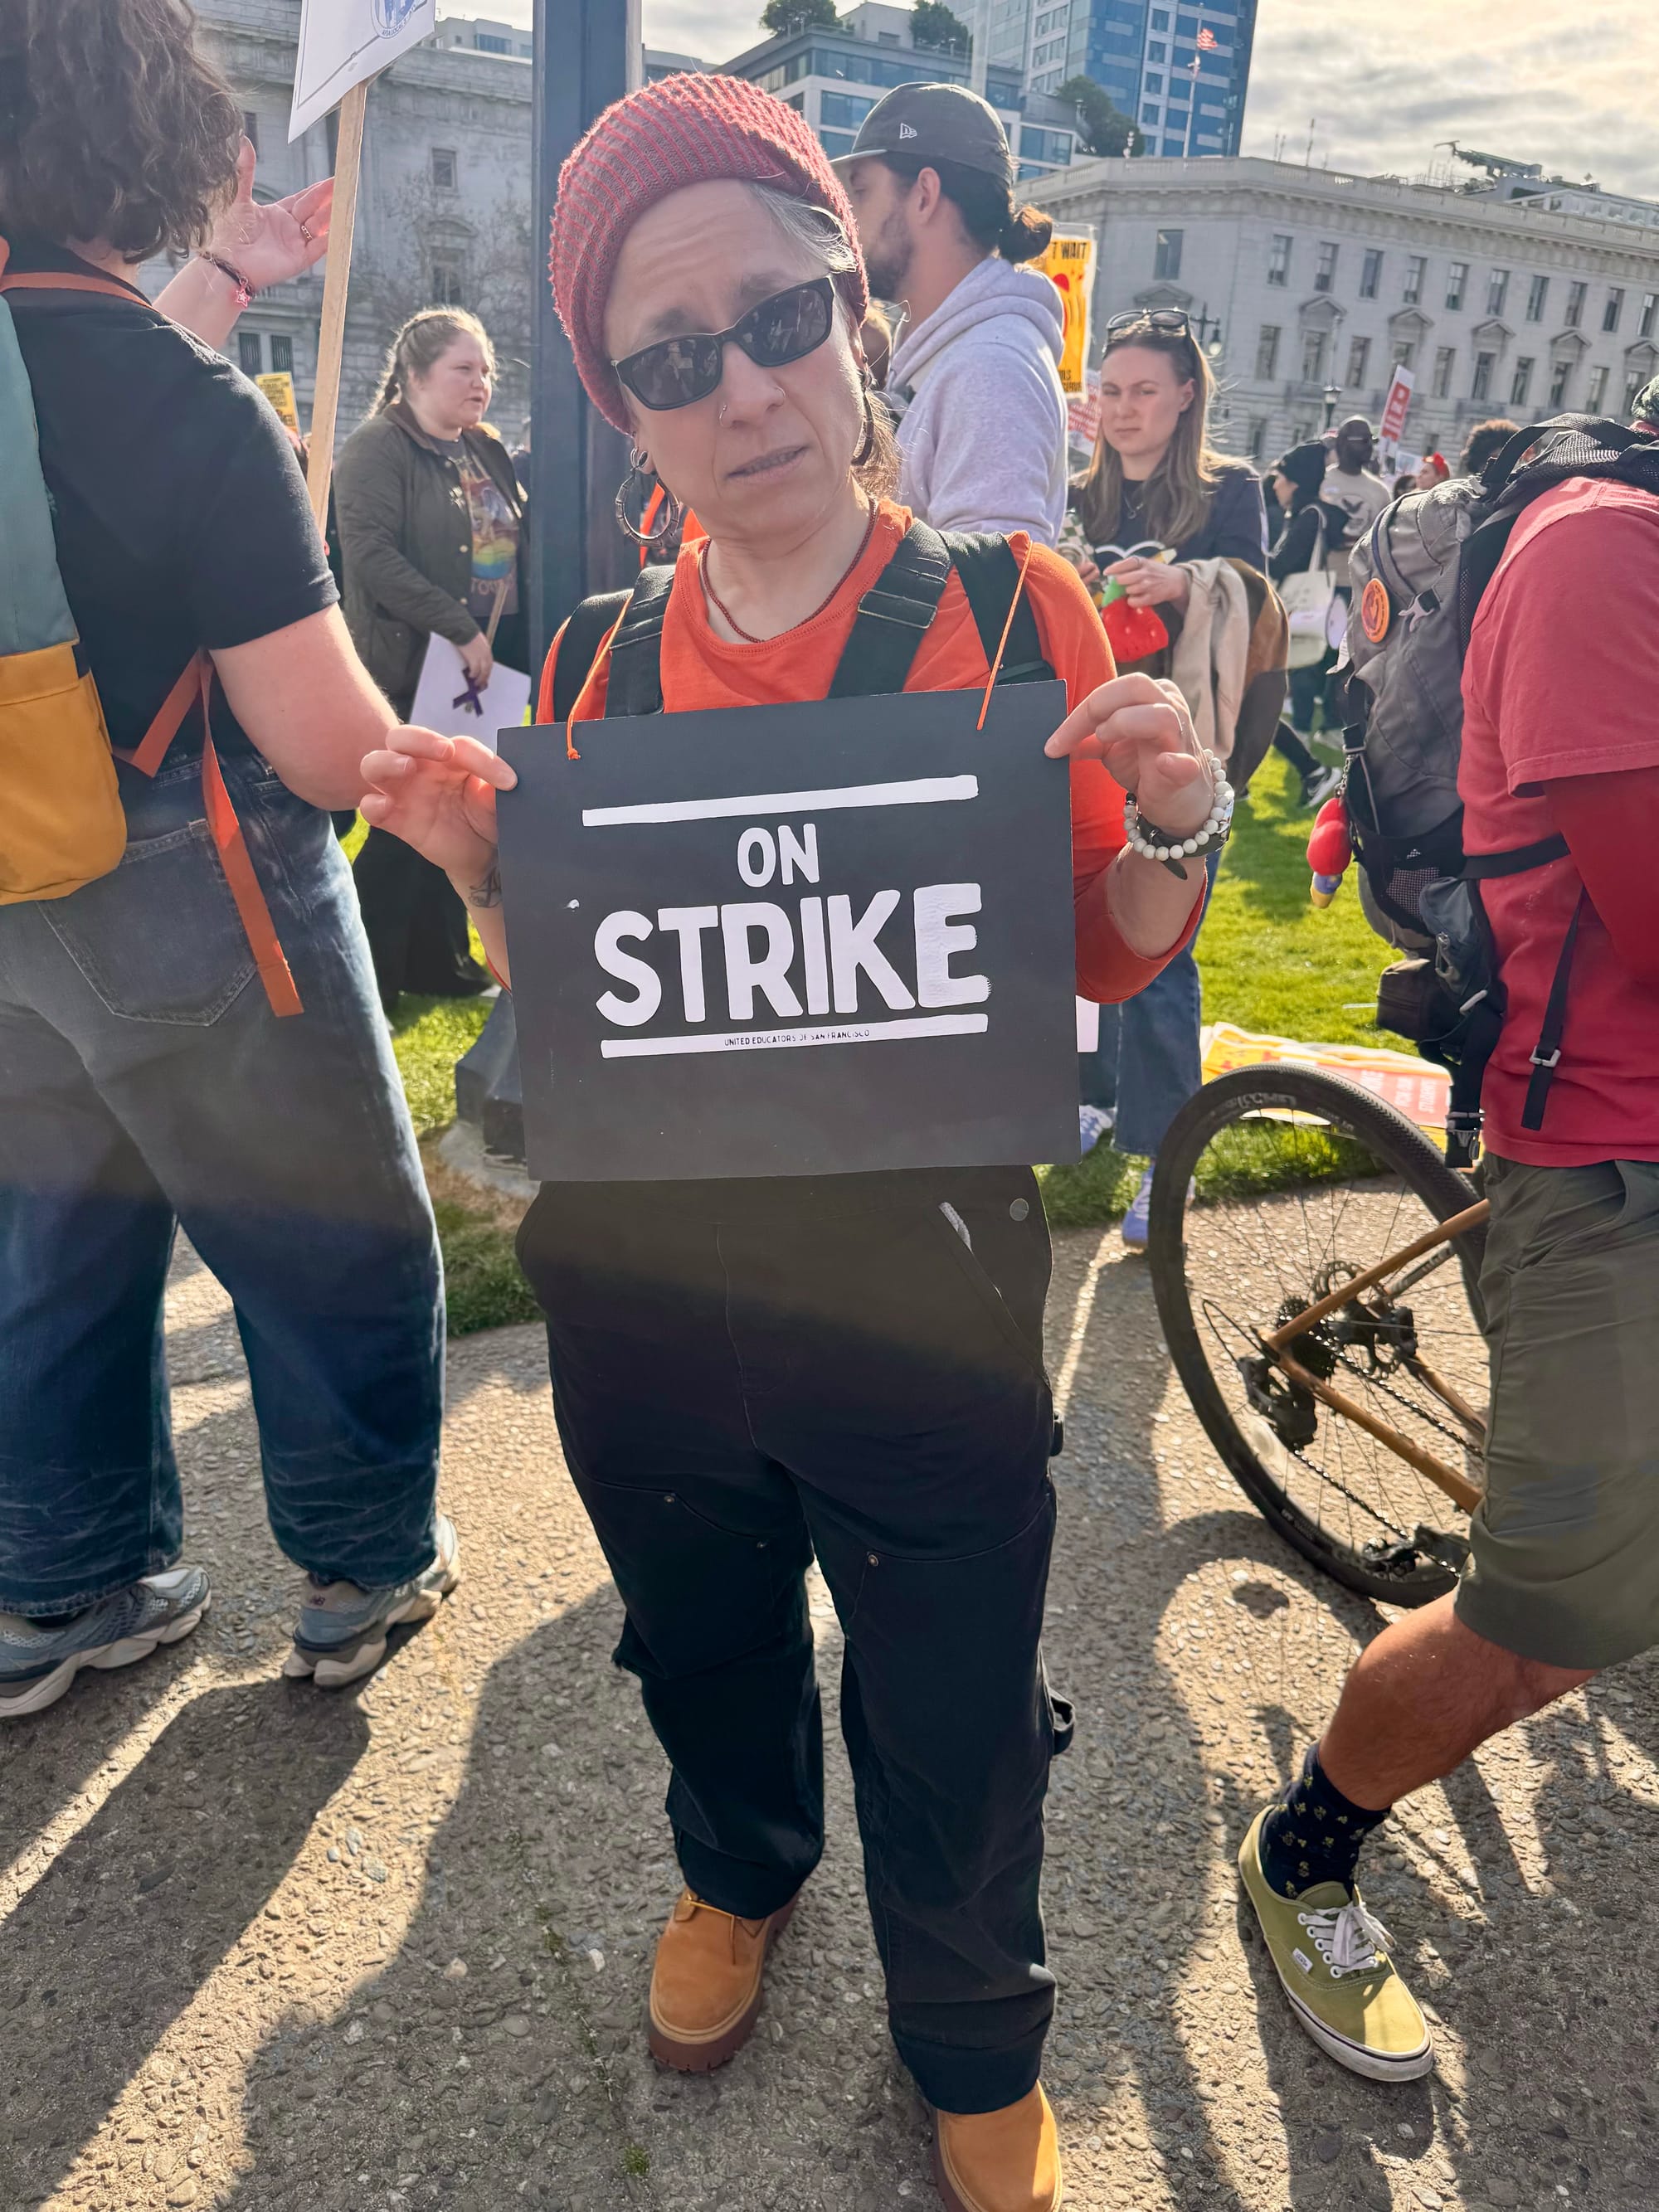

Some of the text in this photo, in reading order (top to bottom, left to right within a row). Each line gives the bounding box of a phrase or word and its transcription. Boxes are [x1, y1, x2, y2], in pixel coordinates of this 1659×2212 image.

[1061, 241, 1087, 260] WAIT
[737, 823, 820, 887] ON
[594, 882, 991, 1026] STRIKE
[724, 1037, 750, 1047] UNITED
[752, 1034, 796, 1045] EDUCATORS
